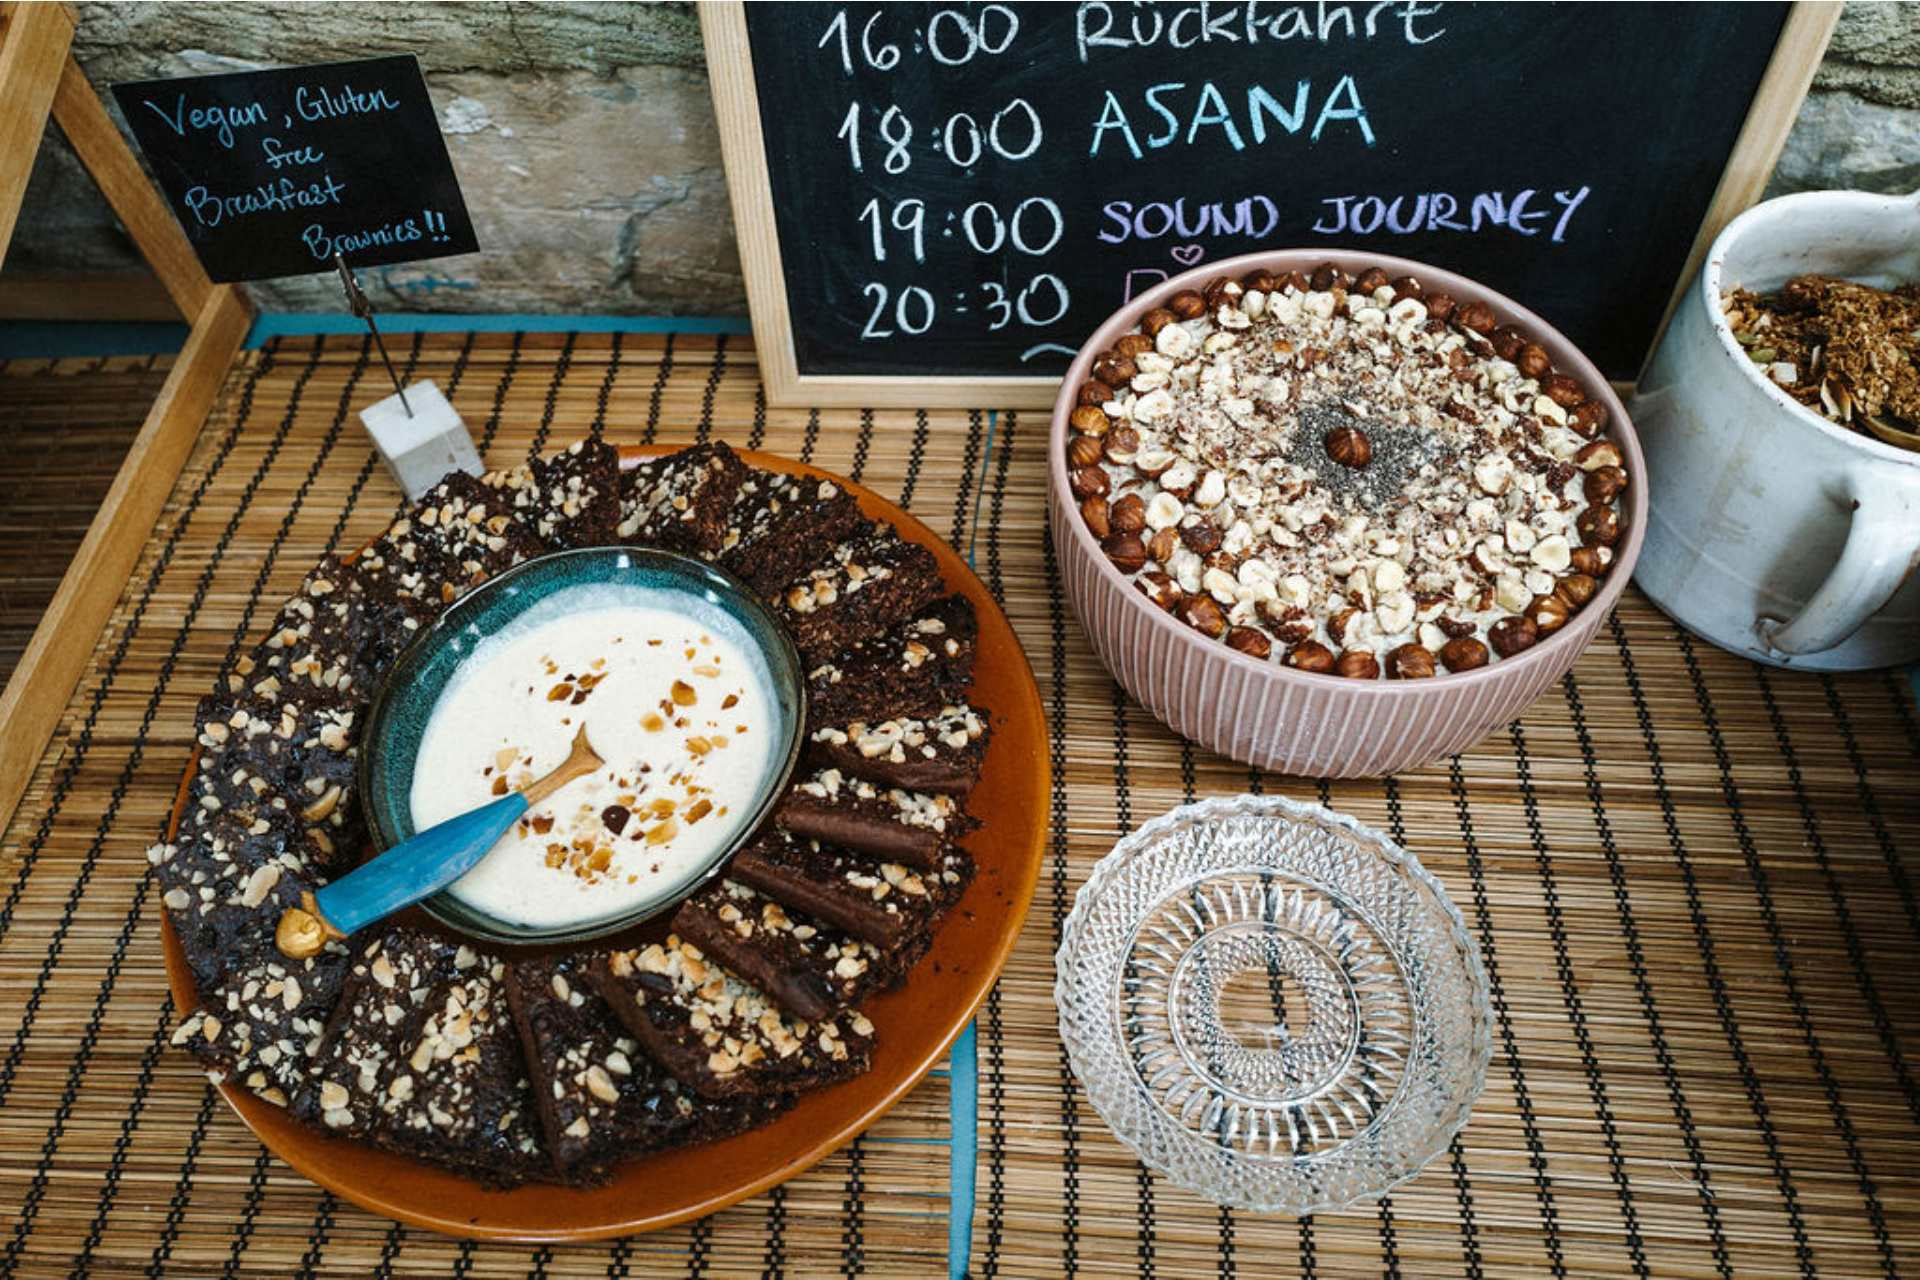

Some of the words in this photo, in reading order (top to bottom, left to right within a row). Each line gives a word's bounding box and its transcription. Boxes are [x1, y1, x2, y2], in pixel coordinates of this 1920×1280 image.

[818, 4, 1019, 76] 16:00
[144, 95, 268, 148] Vegan
[837, 98, 1043, 174] 18:00
[1089, 75, 1377, 159] ASANA
[261, 137, 324, 169] free
[184, 174, 346, 226] Breakfast
[858, 197, 1064, 264] 19:00
[1097, 195, 1280, 244] SOUND
[1312, 185, 1592, 242] JOURNEY
[302, 209, 451, 260] Brownies!!
